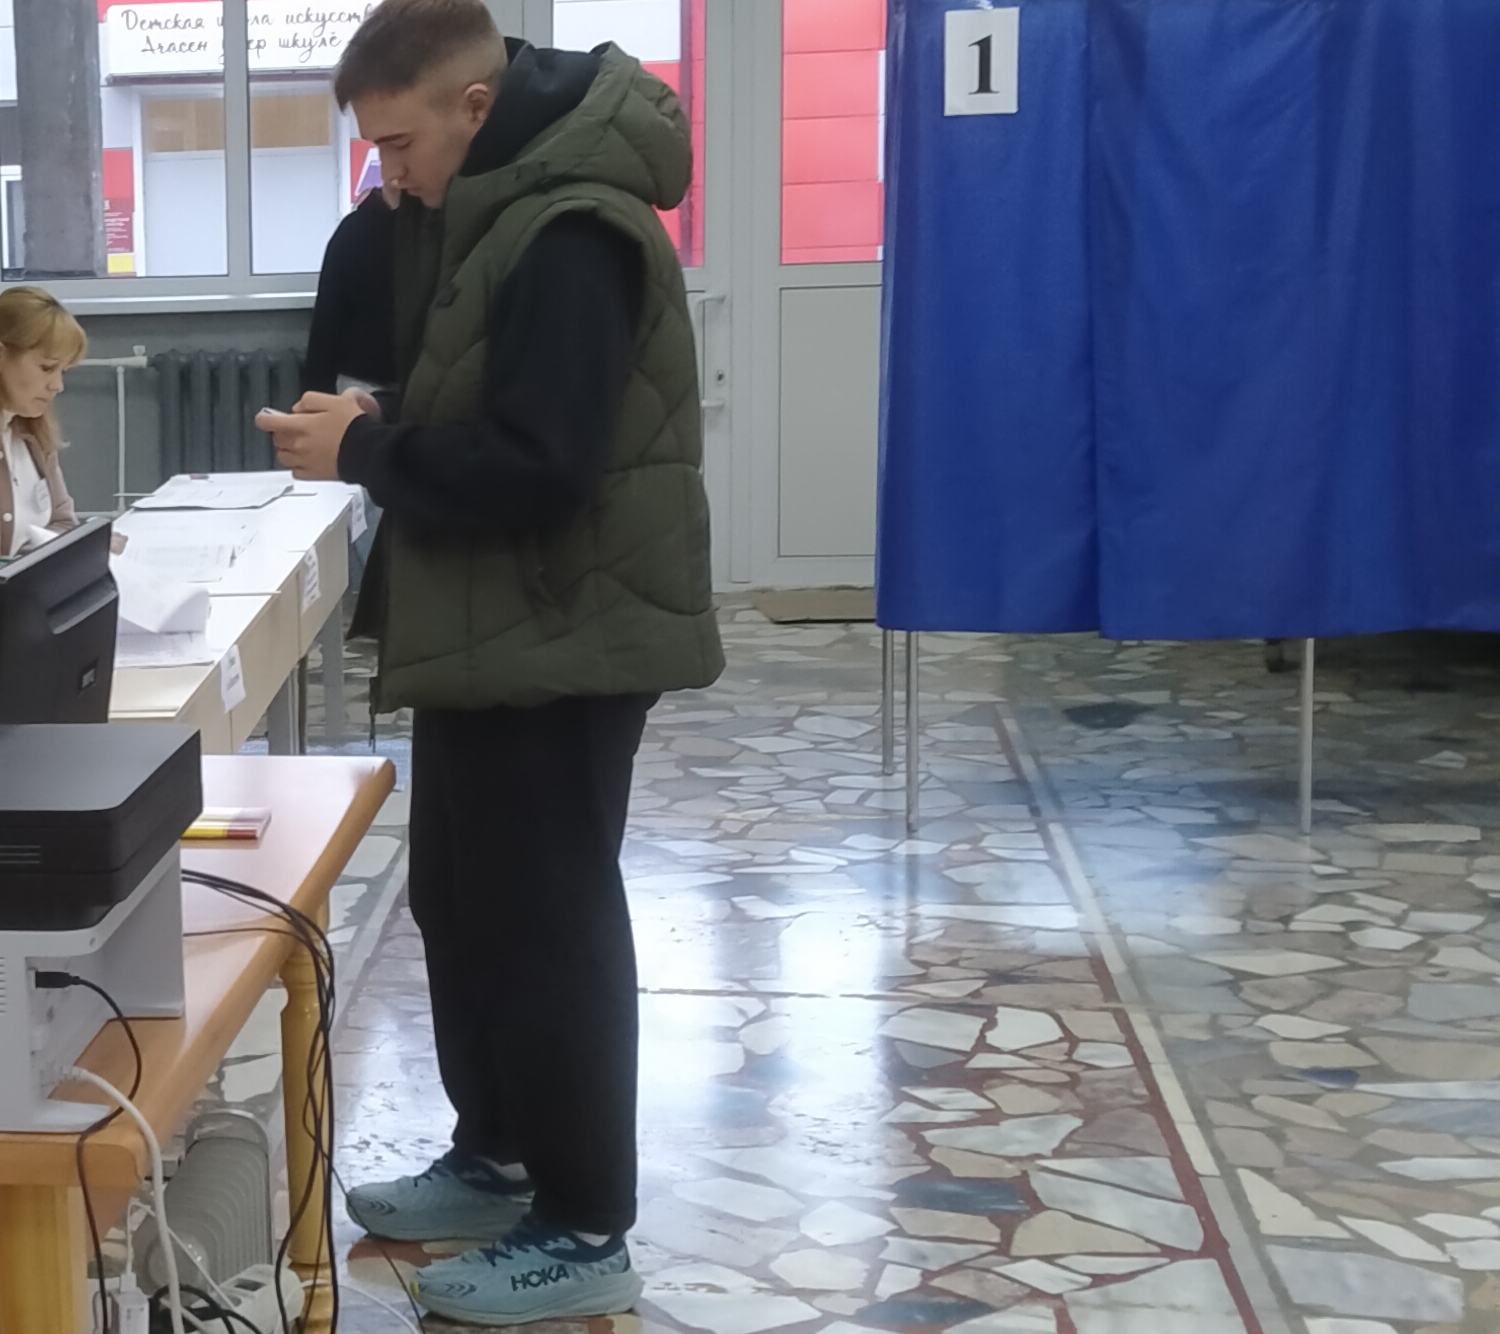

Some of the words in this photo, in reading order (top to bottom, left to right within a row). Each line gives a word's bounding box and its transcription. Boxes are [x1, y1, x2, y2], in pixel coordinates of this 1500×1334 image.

[120, 9, 205, 31] Детская
[968, 34, 1000, 95] 1
[510, 1264, 570, 1292] HOKA
